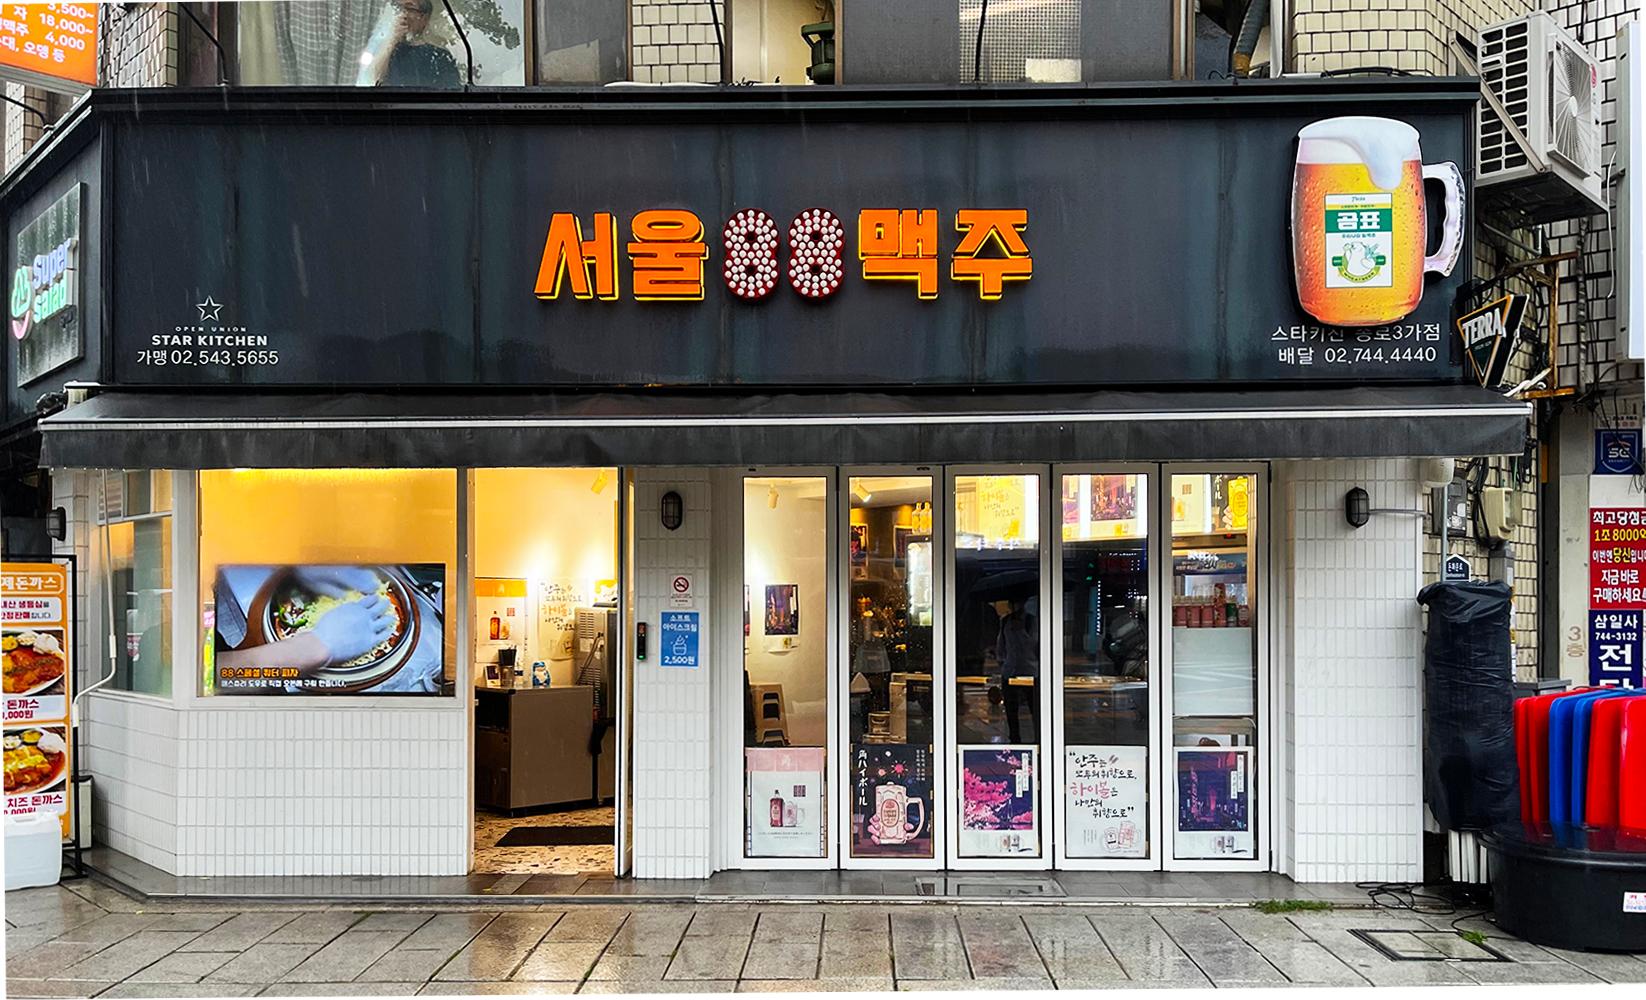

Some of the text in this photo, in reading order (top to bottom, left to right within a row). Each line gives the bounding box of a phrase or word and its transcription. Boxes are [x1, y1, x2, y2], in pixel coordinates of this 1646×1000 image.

[39, 13, 94, 34] 18,000~
[0, 18, 86, 50] 맥주 4,000
[0, 35, 65, 63] 대, 오뎅 등
[1337, 211, 1380, 230] 곰표
[1462, 307, 1503, 349] TERRA
[151, 335, 267, 346] STAR KITCHEN
[137, 350, 279, 366] 가맹 02.543.5655
[1278, 346, 1437, 365] 배달 02.744.4440
[1594, 529, 1611, 541] 1조
[662, 623, 697, 632] 아이스크림
[1595, 614, 1638, 629] 삼일사
[1595, 632, 1638, 640] 744-3132
[664, 656, 695, 665] 2,500원
[221, 668, 234, 677] 88
[7, 699, 39, 710] 돈까스
[858, 749, 869, 807] 角ハイボール
[1070, 781, 1118, 799] 하이볼은
[7, 793, 63, 808] 치즈 돈까스
